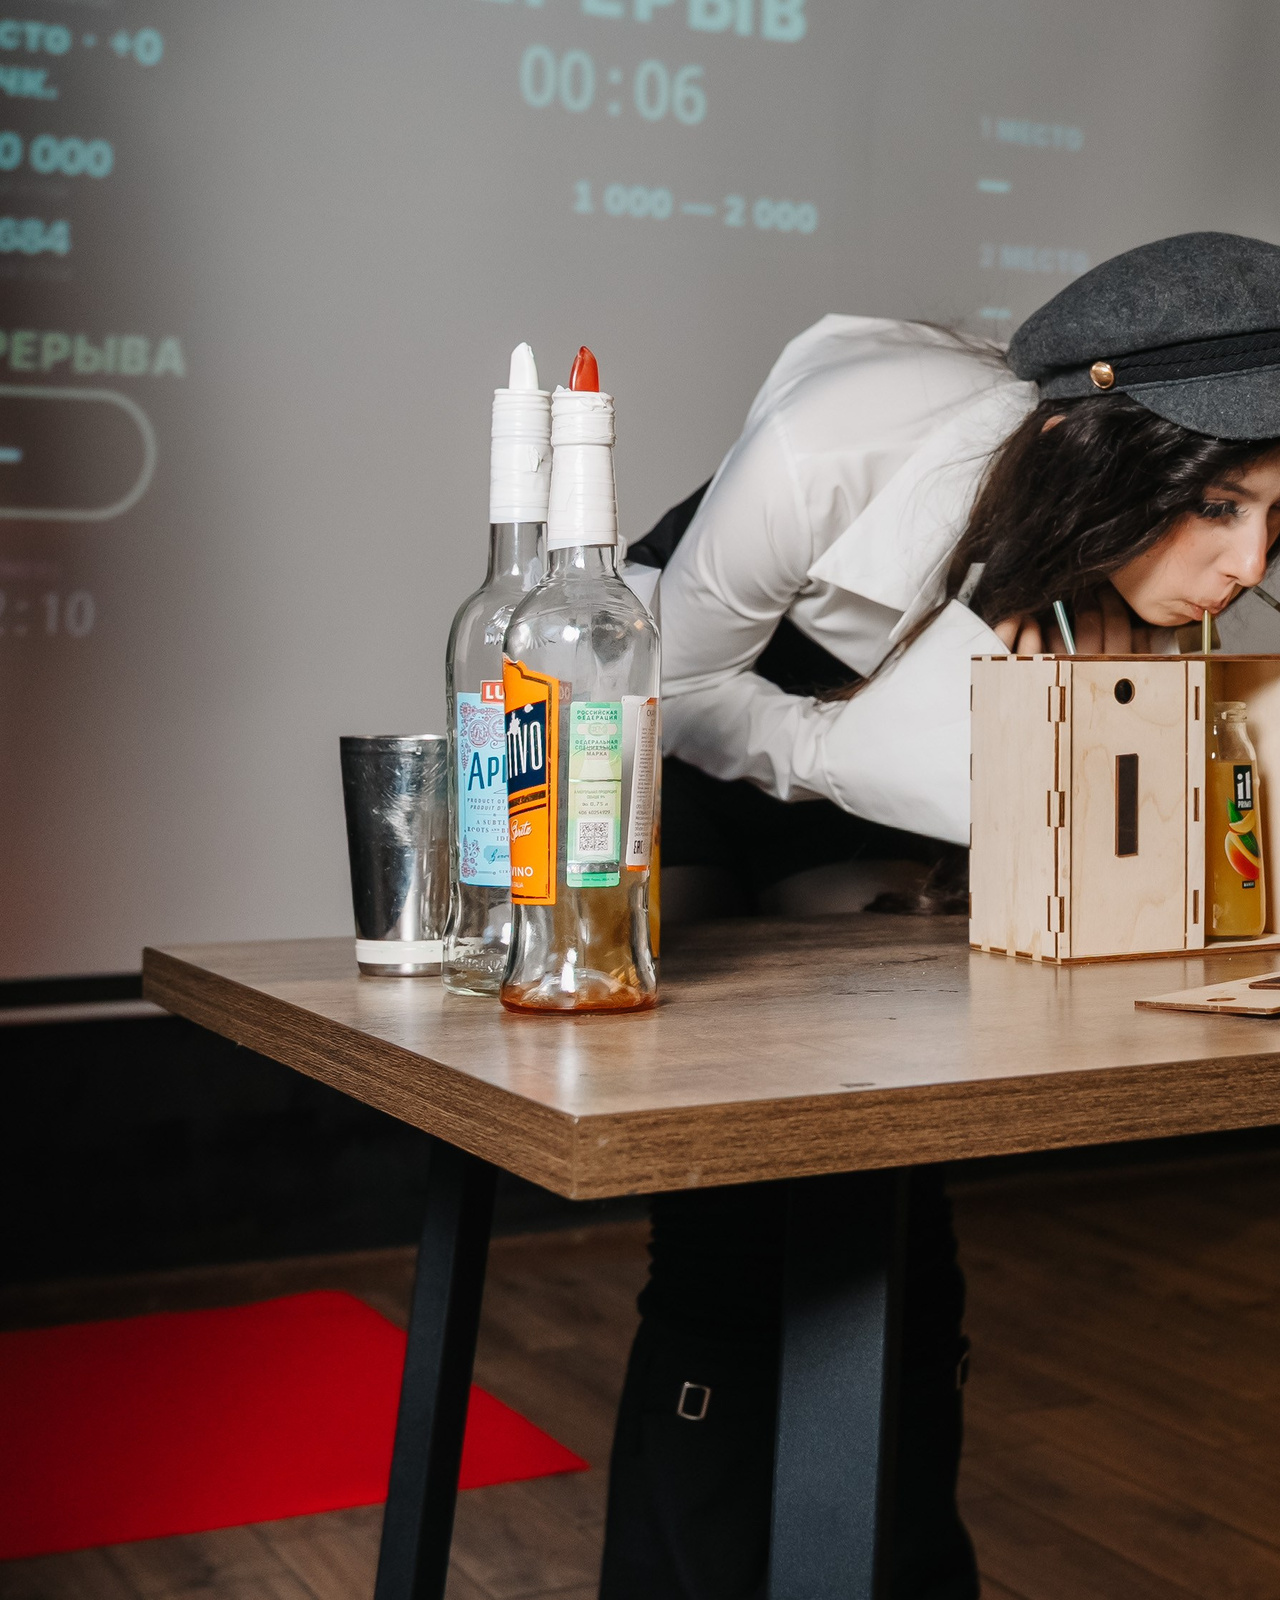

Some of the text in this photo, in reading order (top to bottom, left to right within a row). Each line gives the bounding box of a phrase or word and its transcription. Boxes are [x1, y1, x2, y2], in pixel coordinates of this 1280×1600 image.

[519, 43, 708, 125] 00:06
[29, 134, 114, 178] 000
[574, 179, 595, 214] 1
[603, 183, 674, 220] 000
[753, 199, 818, 234] 000
[485, 685, 504, 699] LU
[467, 751, 506, 791] AP
